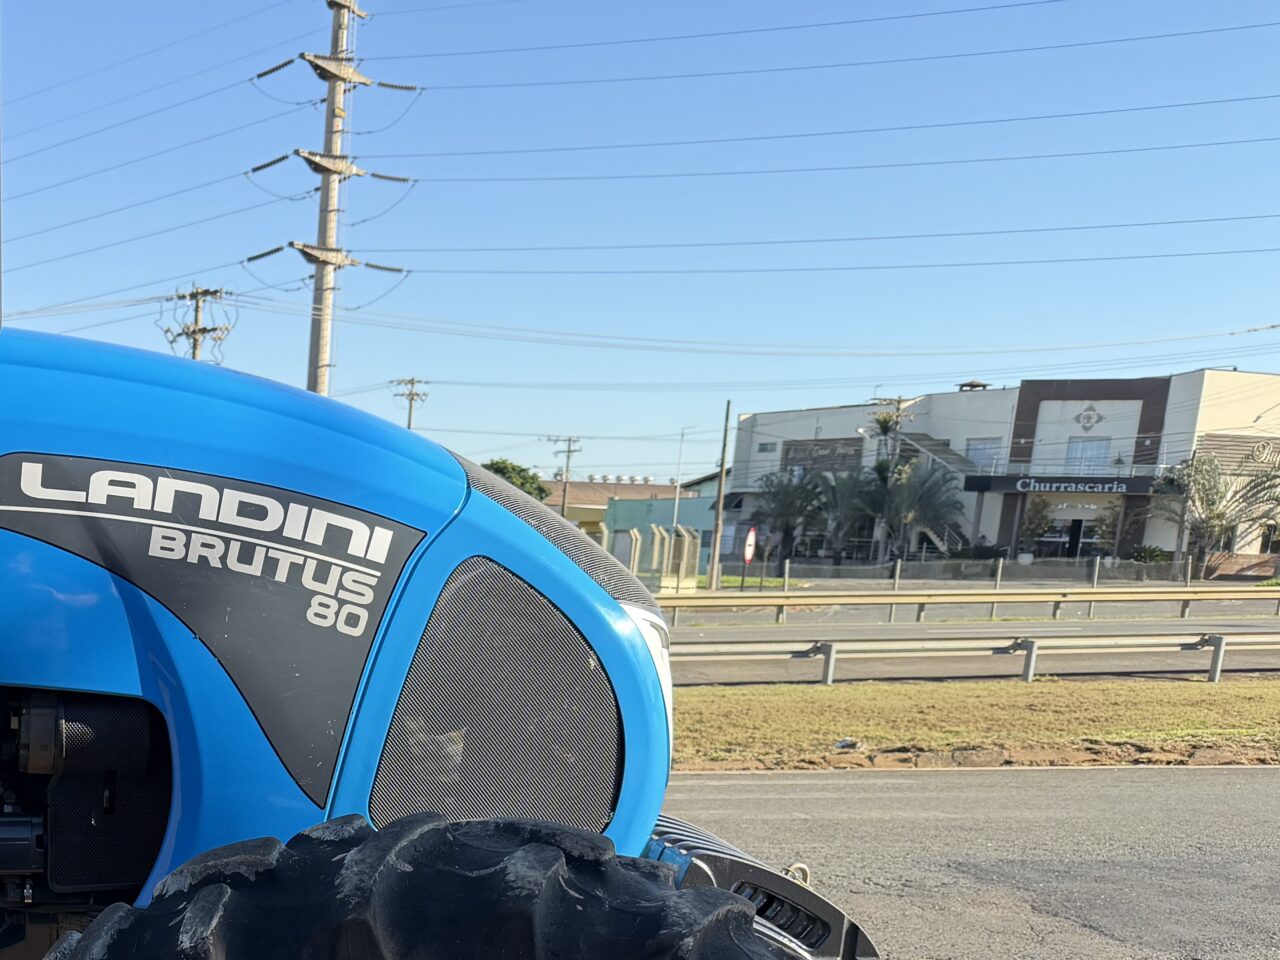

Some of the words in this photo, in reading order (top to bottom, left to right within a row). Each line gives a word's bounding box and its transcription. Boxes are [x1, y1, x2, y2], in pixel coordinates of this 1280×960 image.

[20, 462, 393, 563] LANDINI
[1016, 478, 1127, 492] Churrascaria
[148, 526, 379, 605] BRUTUS
[306, 595, 369, 637] 80
